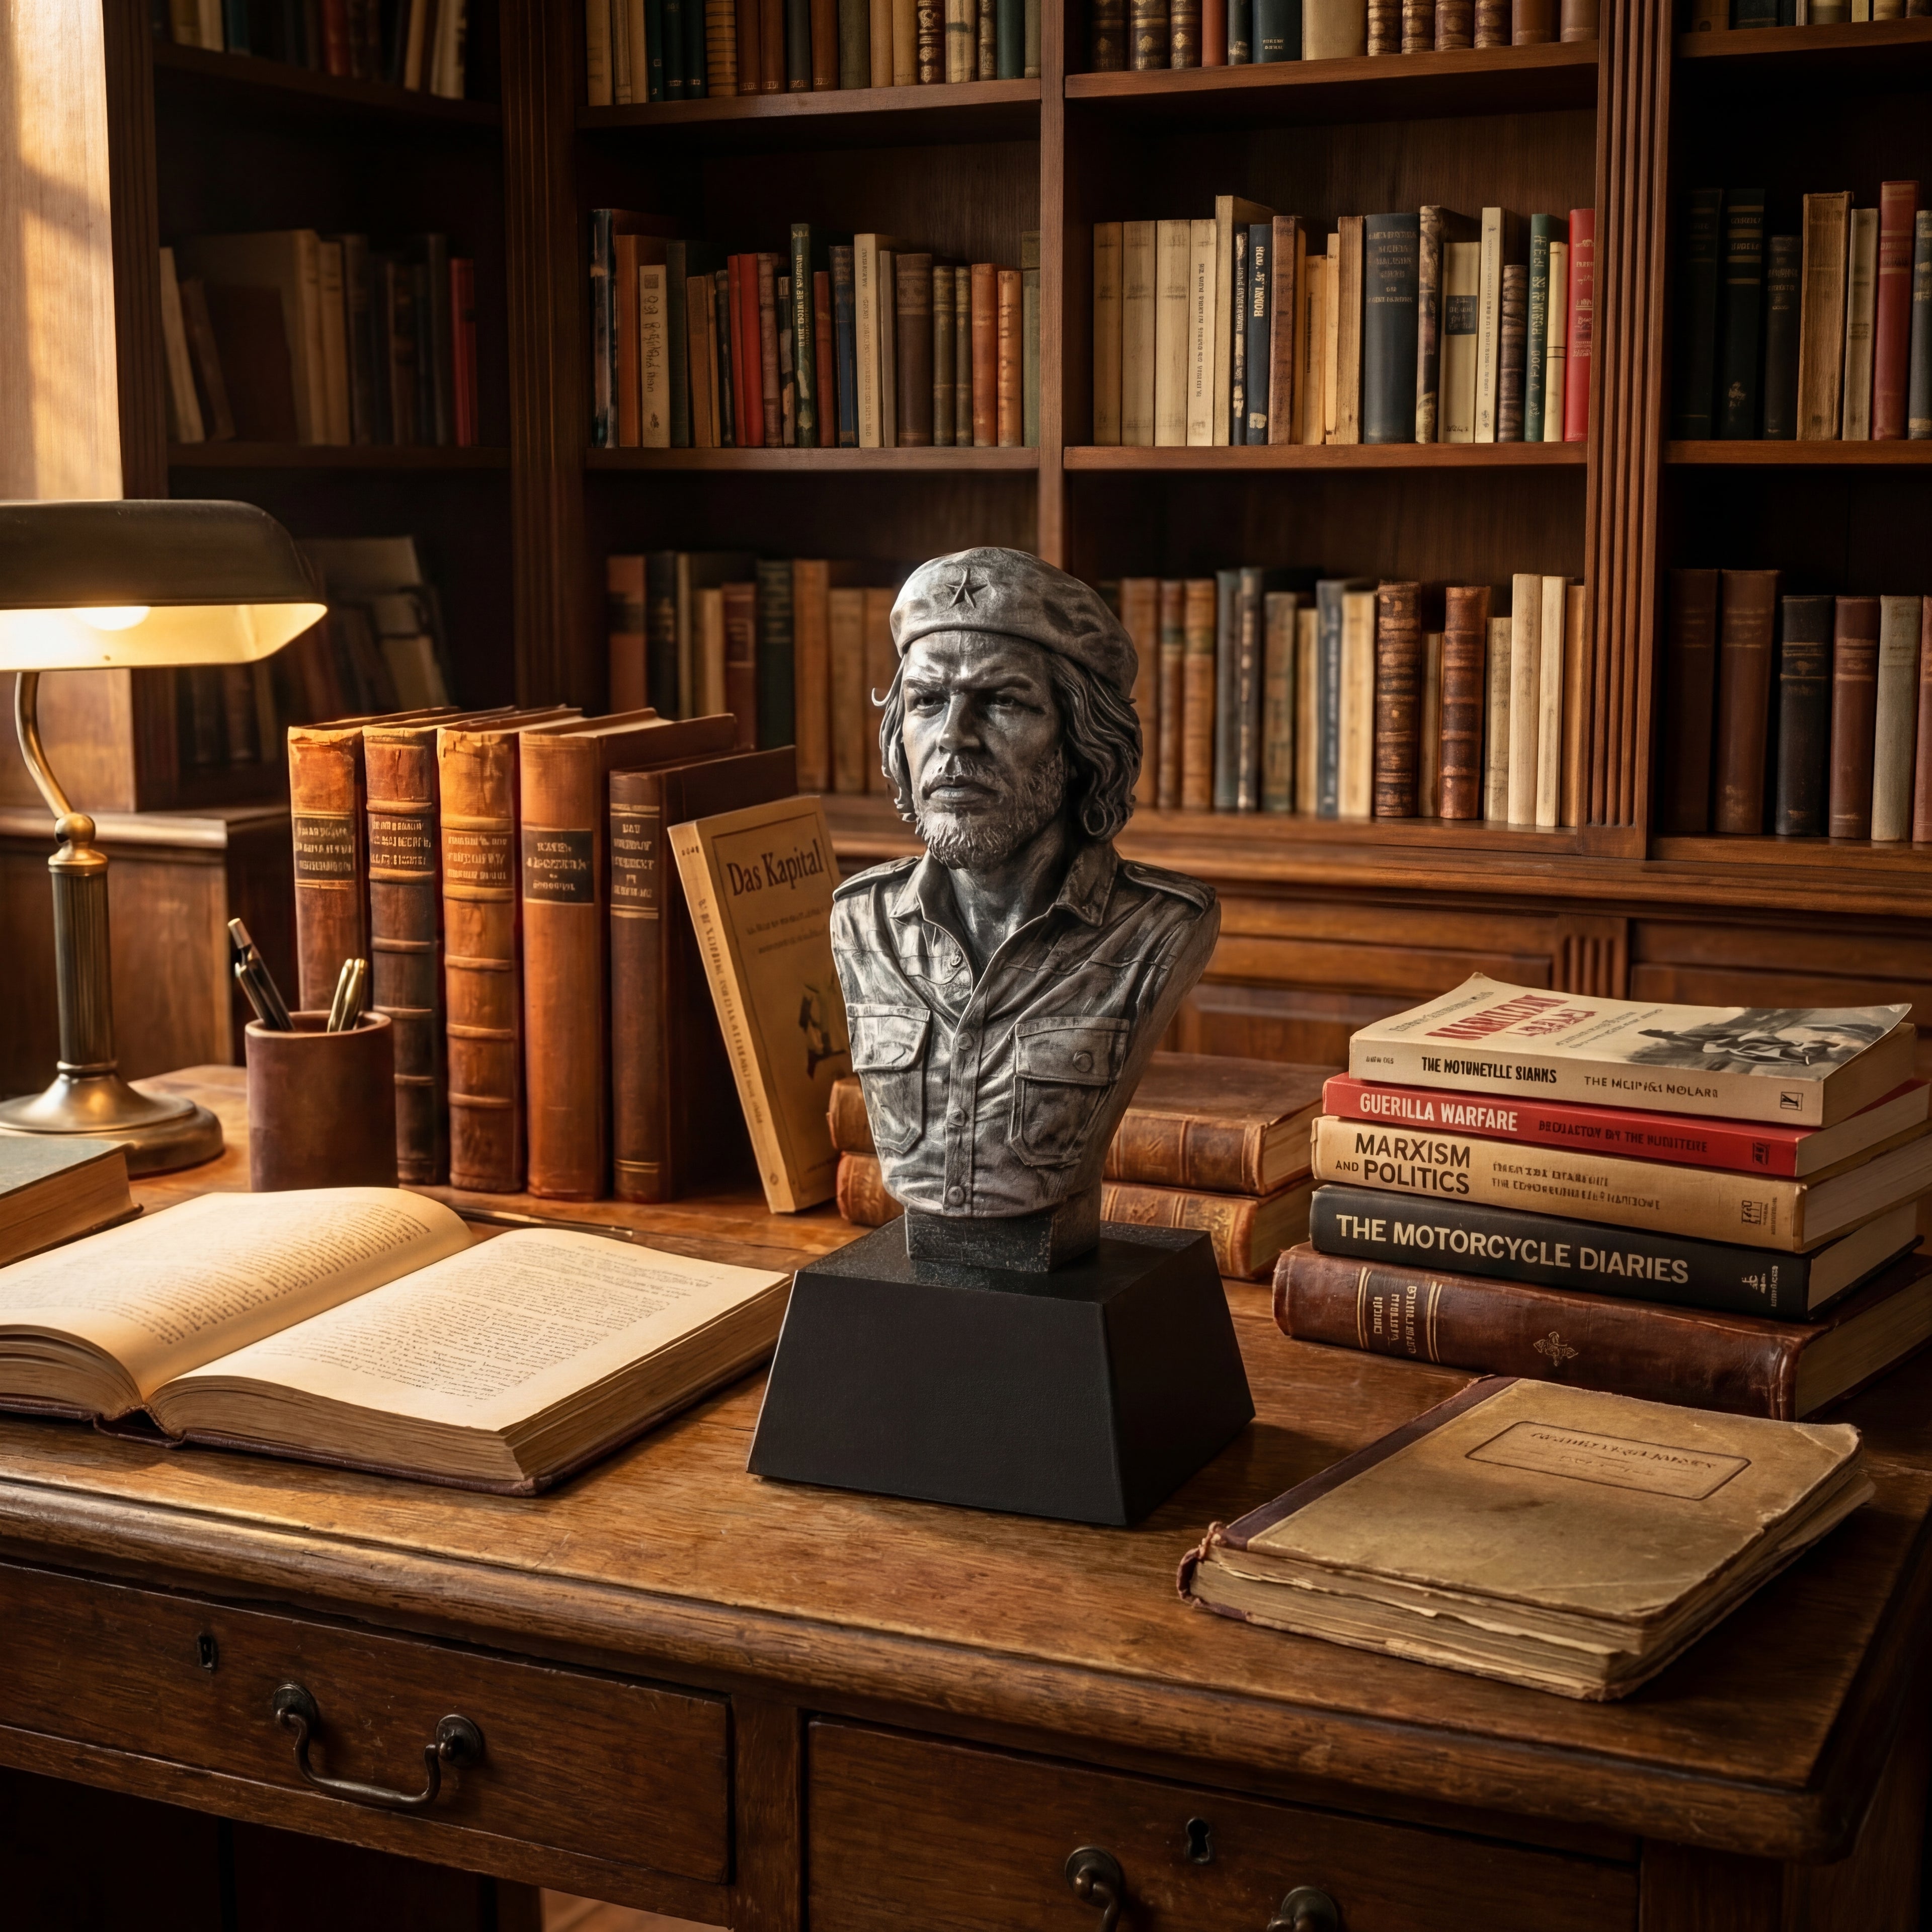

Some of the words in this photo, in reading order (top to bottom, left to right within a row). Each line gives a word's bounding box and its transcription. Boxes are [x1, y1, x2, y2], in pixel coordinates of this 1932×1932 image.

[727, 862, 762, 896] Das
[761, 839, 824, 889] Kapital
[1421, 1057, 1441, 1073] THE
[1584, 1076, 1607, 1087] THE
[1360, 1092, 1435, 1121] GUERILLA
[1440, 1102, 1518, 1132] WARFARE
[1355, 1133, 1471, 1168] MARXISM
[1625, 1132, 1644, 1145] THE
[1335, 1160, 1359, 1172] AND
[1364, 1159, 1470, 1195] POLITICS
[1336, 1214, 1387, 1242] THE
[1393, 1222, 1571, 1268] MOTORCYCLE
[1579, 1247, 1689, 1283] DIARIES
